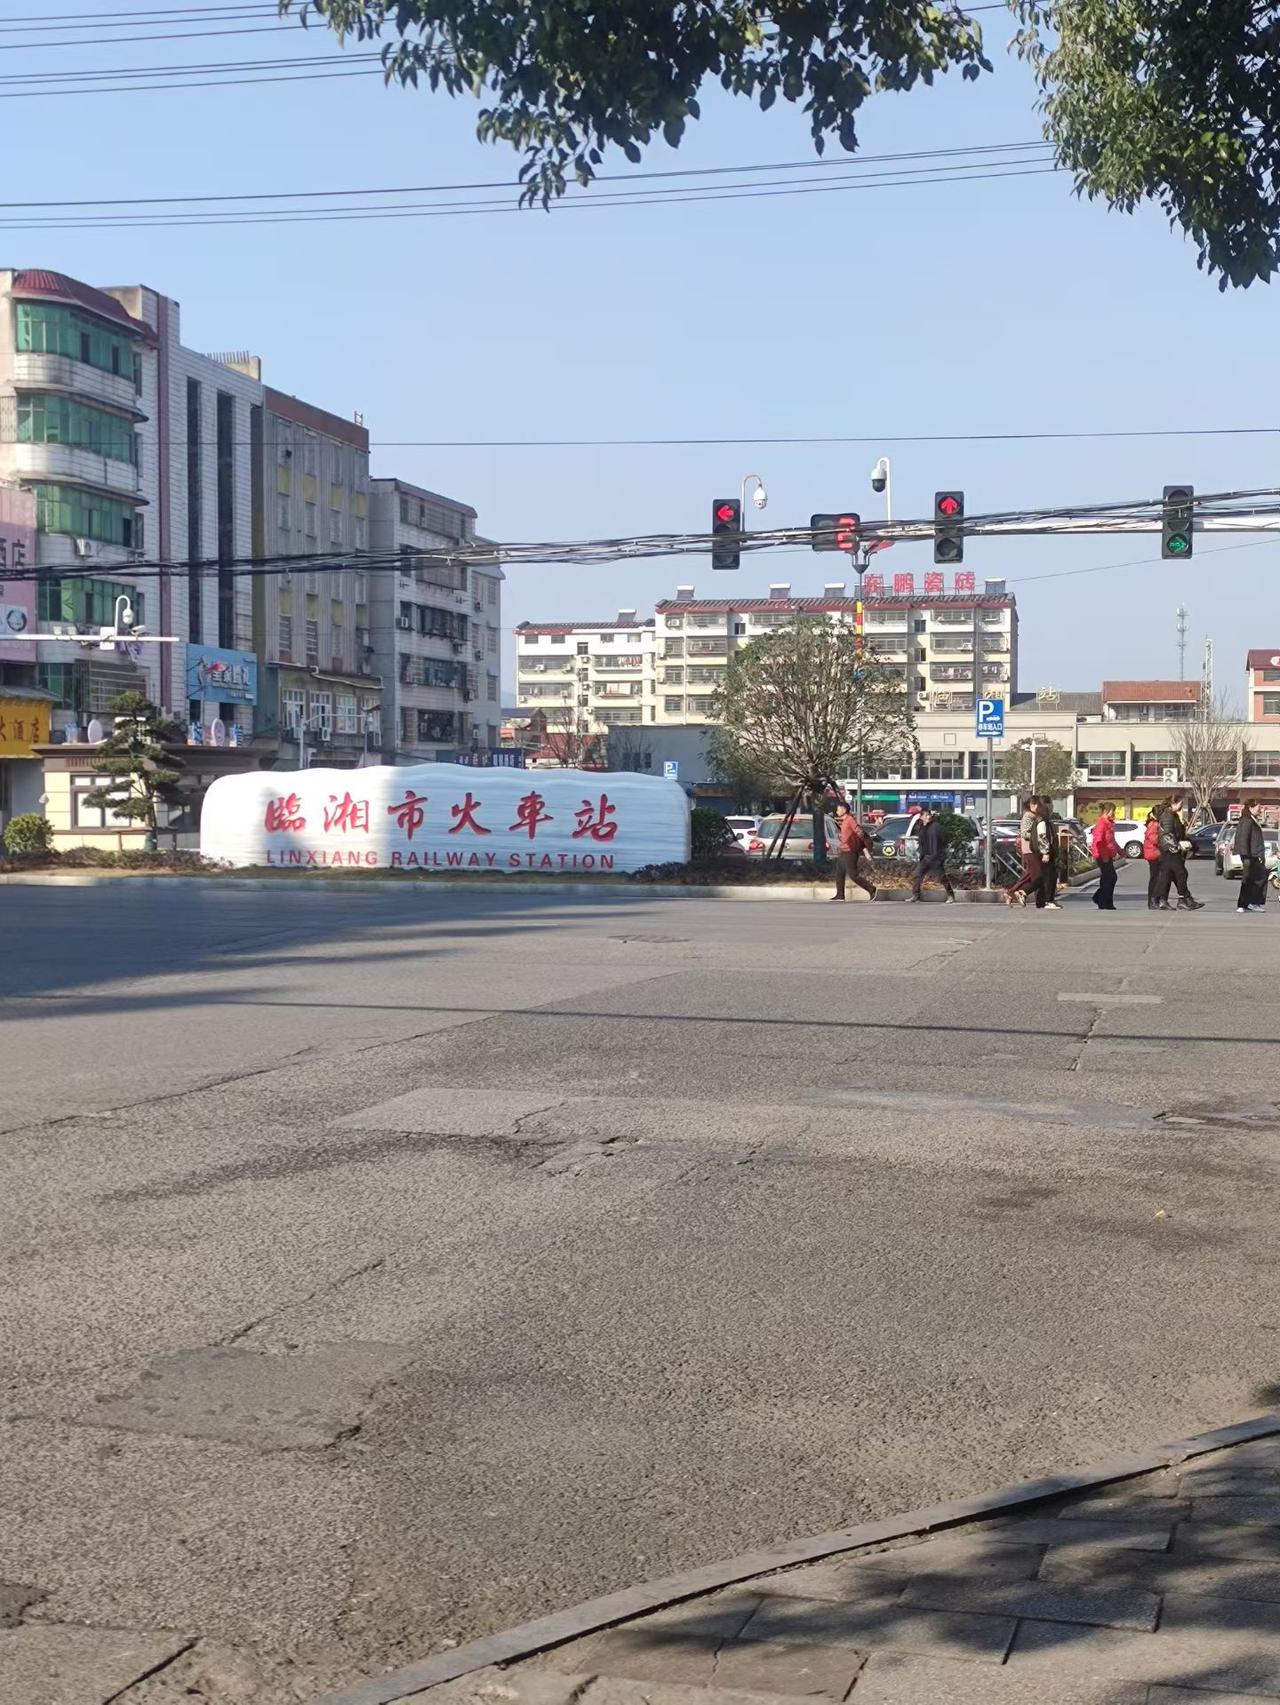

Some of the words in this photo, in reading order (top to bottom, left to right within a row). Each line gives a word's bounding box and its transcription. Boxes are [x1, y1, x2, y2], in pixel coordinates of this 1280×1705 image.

[979, 701, 994, 722] P
[266, 850, 379, 865] LINXIANG
[390, 850, 496, 867] RAILWAY
[509, 852, 614, 869] STATION
